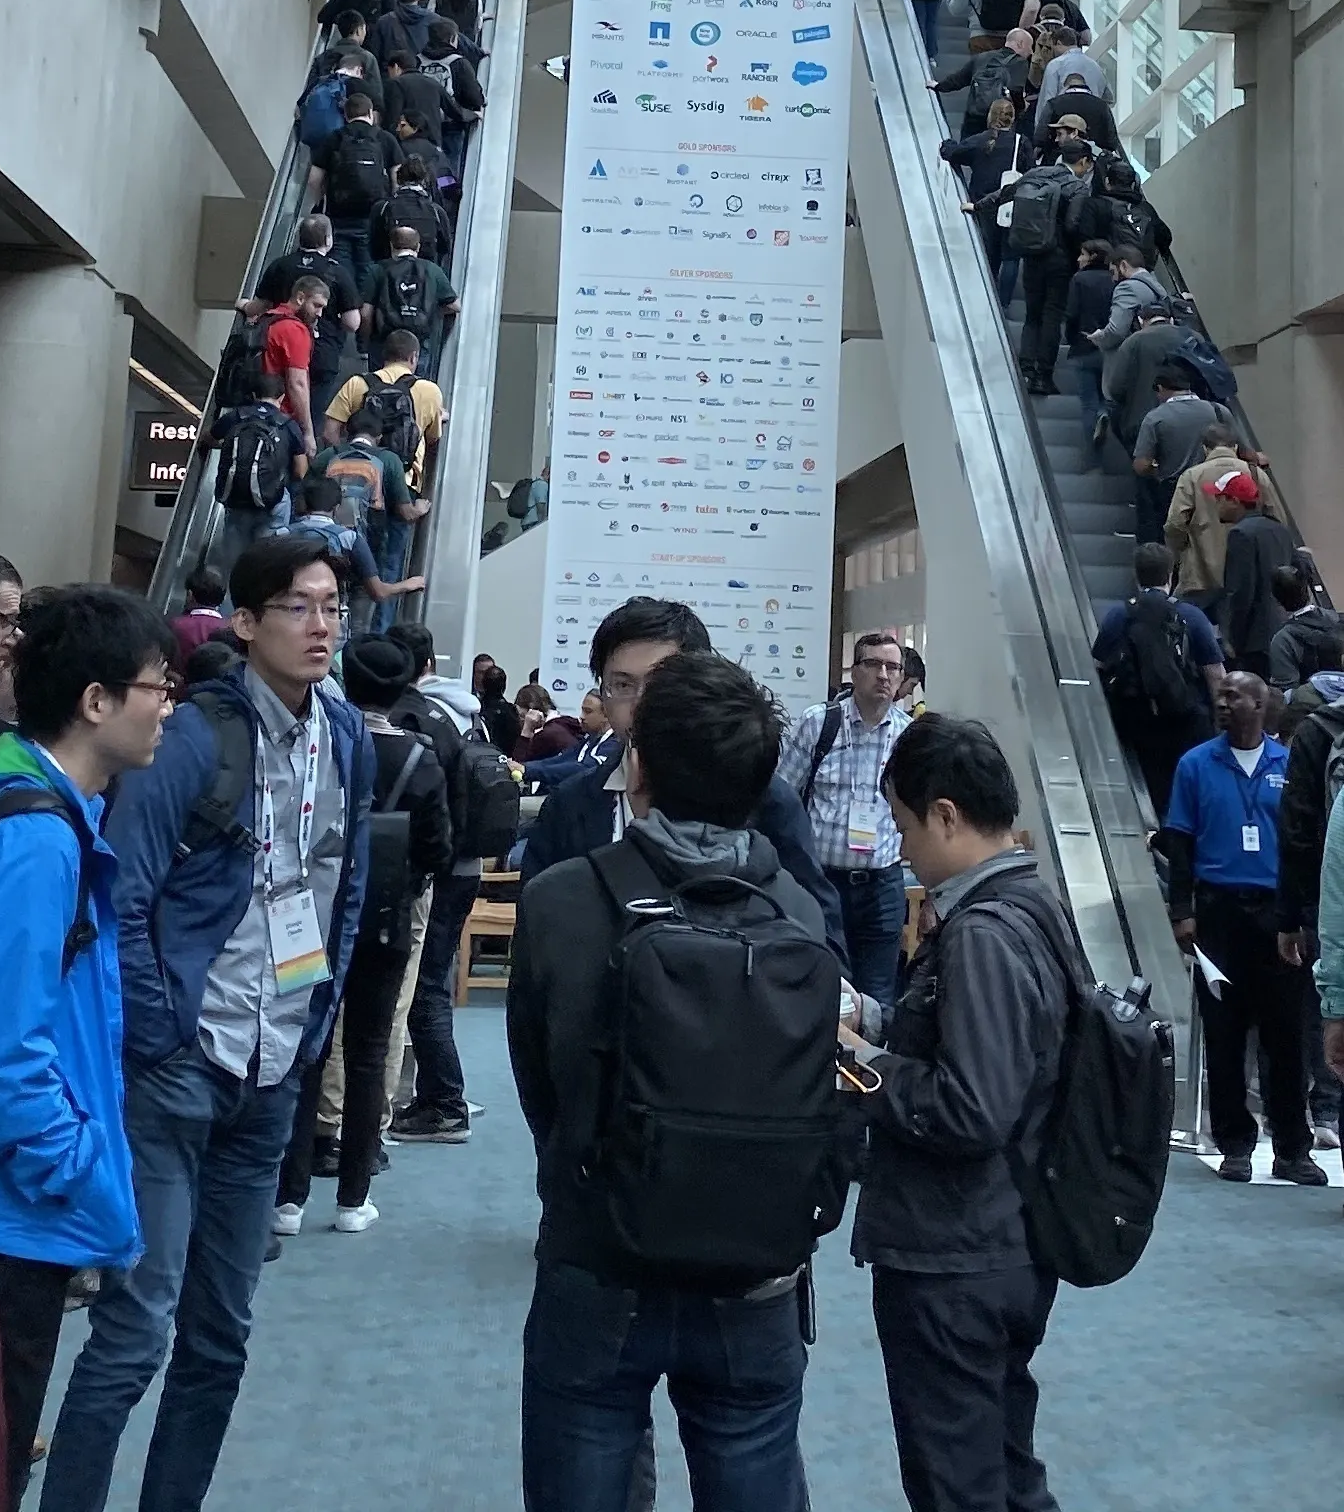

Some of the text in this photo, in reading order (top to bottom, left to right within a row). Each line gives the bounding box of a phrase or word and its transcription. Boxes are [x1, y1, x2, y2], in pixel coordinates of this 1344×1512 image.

[736, 30, 777, 39] ORACLE
[590, 60, 623, 70] Pivotal
[741, 73, 779, 83] RANCHER
[640, 103, 672, 114] SUSE
[686, 99, 725, 114] Sysdig
[739, 115, 772, 123] TIGERA
[677, 142, 737, 152] GOLD SPONSORS
[669, 268, 733, 279] SILVER SPONSORS
[638, 309, 660, 318] arm
[150, 422, 197, 440] Rest
[150, 462, 188, 481] Info
